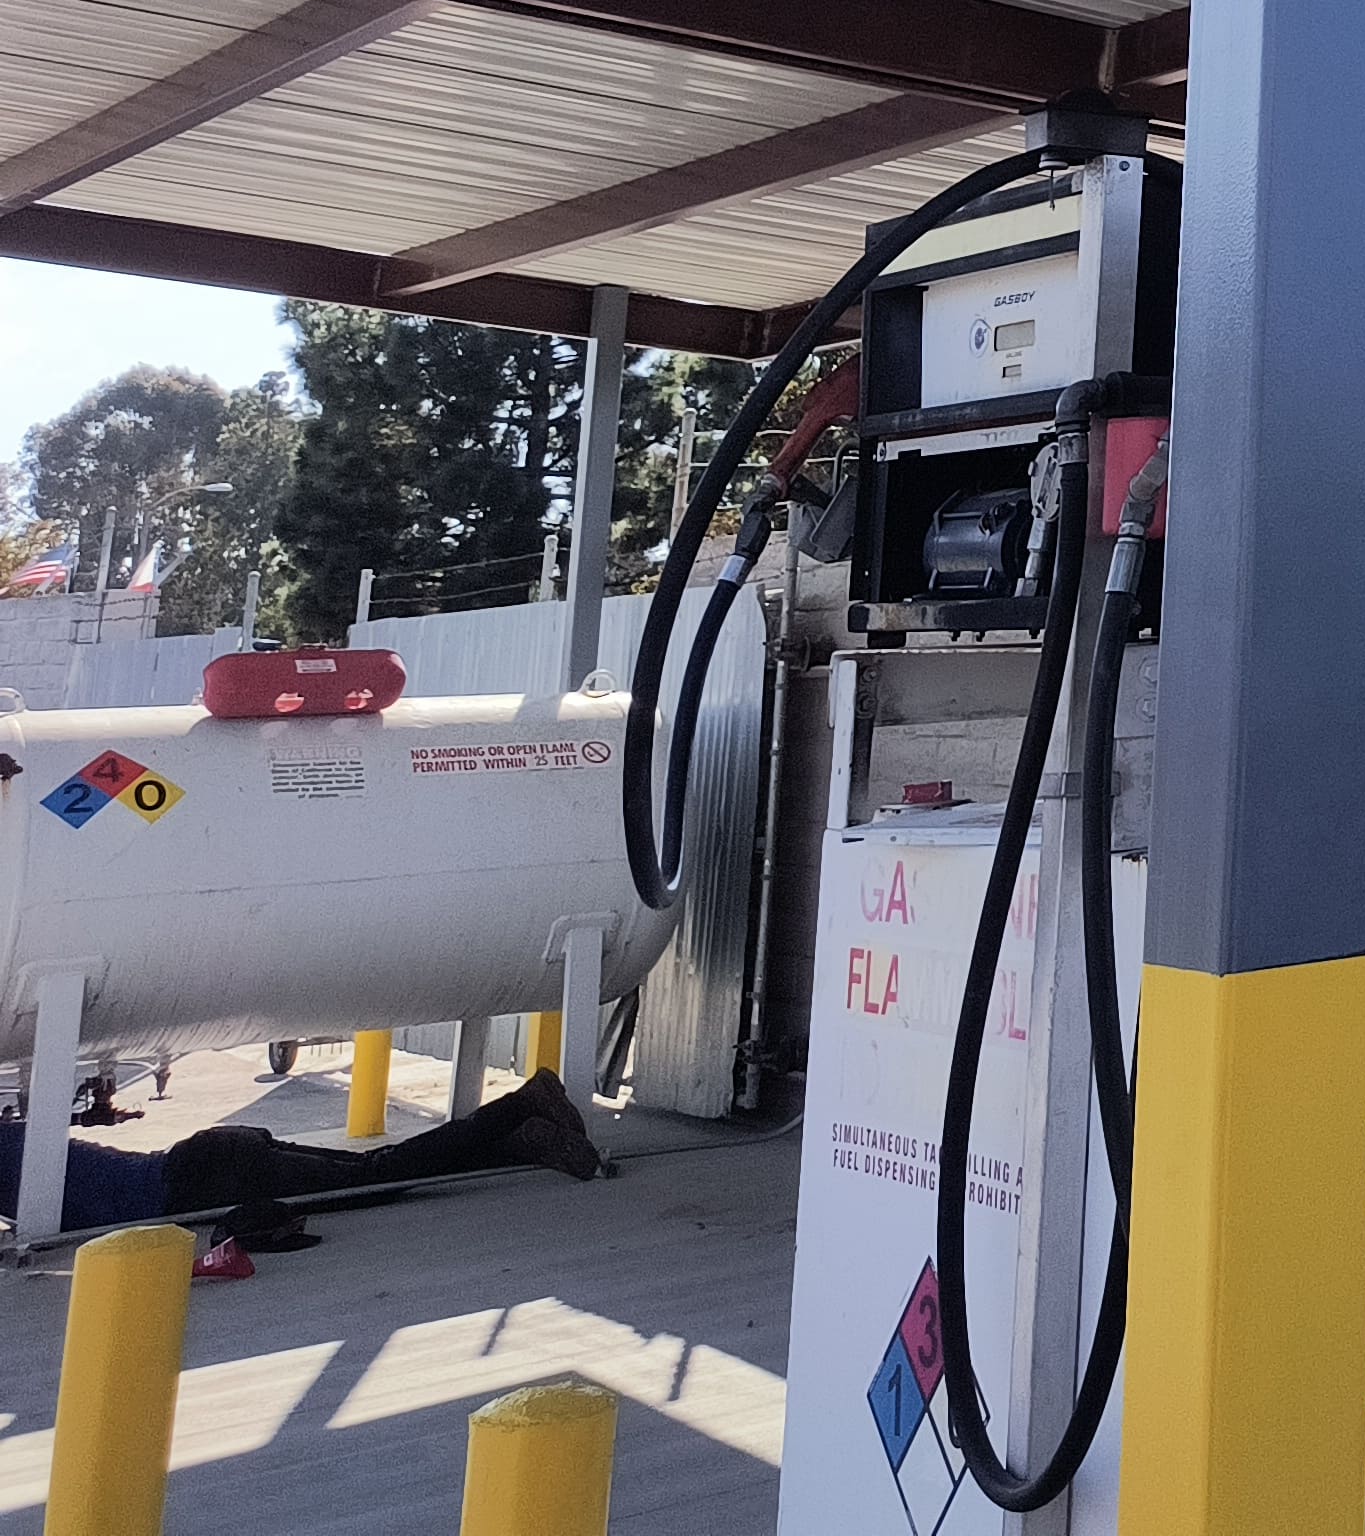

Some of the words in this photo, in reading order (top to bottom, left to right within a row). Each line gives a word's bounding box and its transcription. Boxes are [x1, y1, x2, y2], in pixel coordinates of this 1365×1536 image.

[994, 290, 1036, 307] GASBOY
[411, 749, 428, 760] NO
[431, 747, 485, 759] SMOKING
[488, 745, 504, 756] OR
[508, 744, 537, 756] OPEN
[540, 742, 576, 754] FLAME
[413, 759, 478, 773] PERMITTED
[483, 757, 527, 770] WITHIN
[534, 755, 548, 767] 25
[554, 755, 578, 766] FEET
[92, 758, 124, 783] 4
[63, 783, 93, 814] 2
[134, 779, 167, 811] 0
[832, 1122, 918, 1159] SIMULTANEOUS
[924, 1142, 937, 1164] TA
[968, 1152, 1010, 1183] ILLING
[833, 1148, 859, 1171] FUEL
[864, 1154, 936, 1191] DISPENSING
[968, 1181, 1021, 1215] ROHIBIT
[918, 1295, 938, 1368] 3
[887, 1364, 901, 1437] 1
